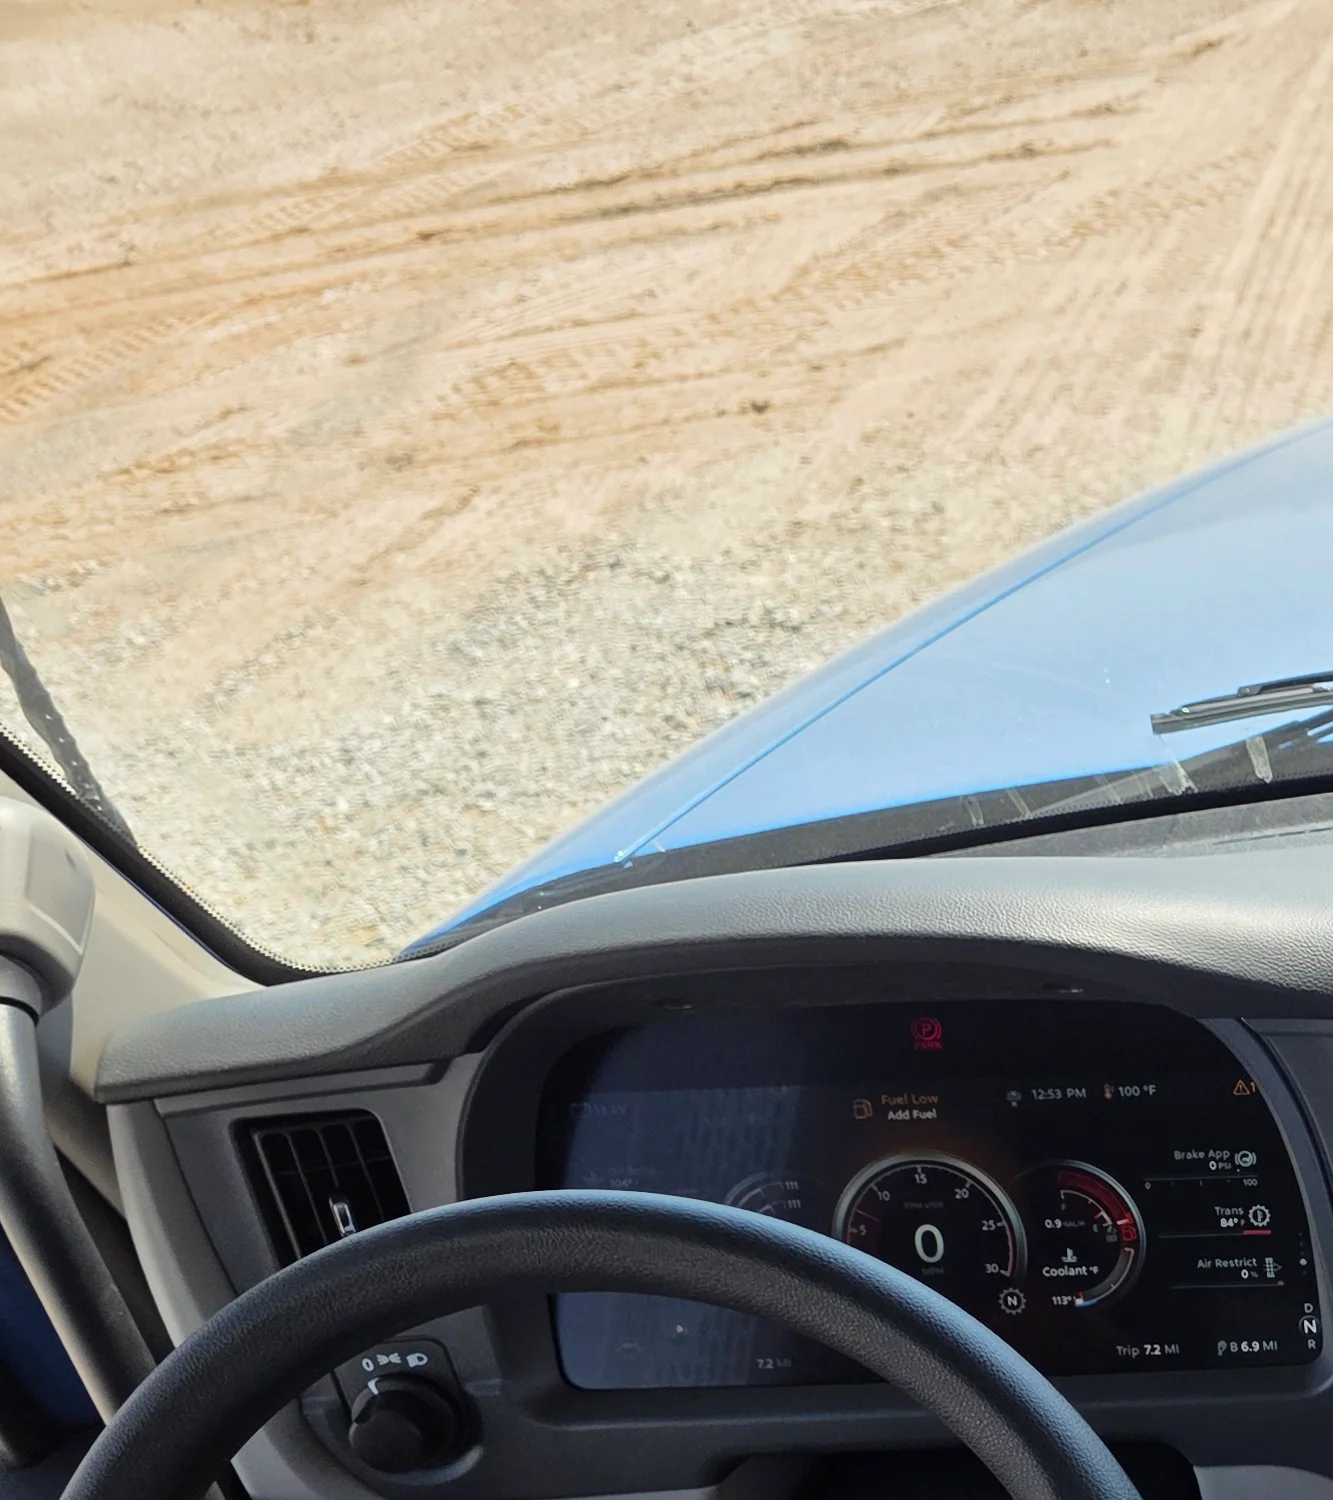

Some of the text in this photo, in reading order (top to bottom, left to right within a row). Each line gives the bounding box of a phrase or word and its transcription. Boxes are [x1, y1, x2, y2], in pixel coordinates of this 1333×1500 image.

[1031, 1088, 1087, 1100] 12:53 PM
[1118, 1086, 1140, 1097] 100
[881, 1094, 938, 1105] Fuel Low
[888, 1109, 937, 1120] Add Fuel
[1174, 1150, 1230, 1161] Brake App
[1209, 1161, 1217, 1170] 0
[915, 1174, 927, 1184] 15
[1243, 1178, 1258, 1187] 100
[877, 1191, 890, 1201] 10
[955, 1188, 969, 1199] 20
[1215, 1206, 1244, 1215] Trans
[982, 1220, 996, 1231] 25
[1044, 1219, 1062, 1228] 0.9
[859, 1225, 867, 1236] 5
[914, 1224, 945, 1263] 0
[1197, 1257, 1257, 1268] Air Restrict
[985, 1264, 999, 1273] 30
[1042, 1265, 1088, 1277] Coolant
[1241, 1270, 1249, 1279] 0
[1007, 1296, 1018, 1306] N
[1304, 1303, 1313, 1313] D
[1303, 1319, 1317, 1334] N
[1241, 1341, 1260, 1352] 6.9
[1263, 1340, 1278, 1350] MI
[1308, 1339, 1316, 1349] R
[1116, 1344, 1180, 1358] Trip 7.2 MI
